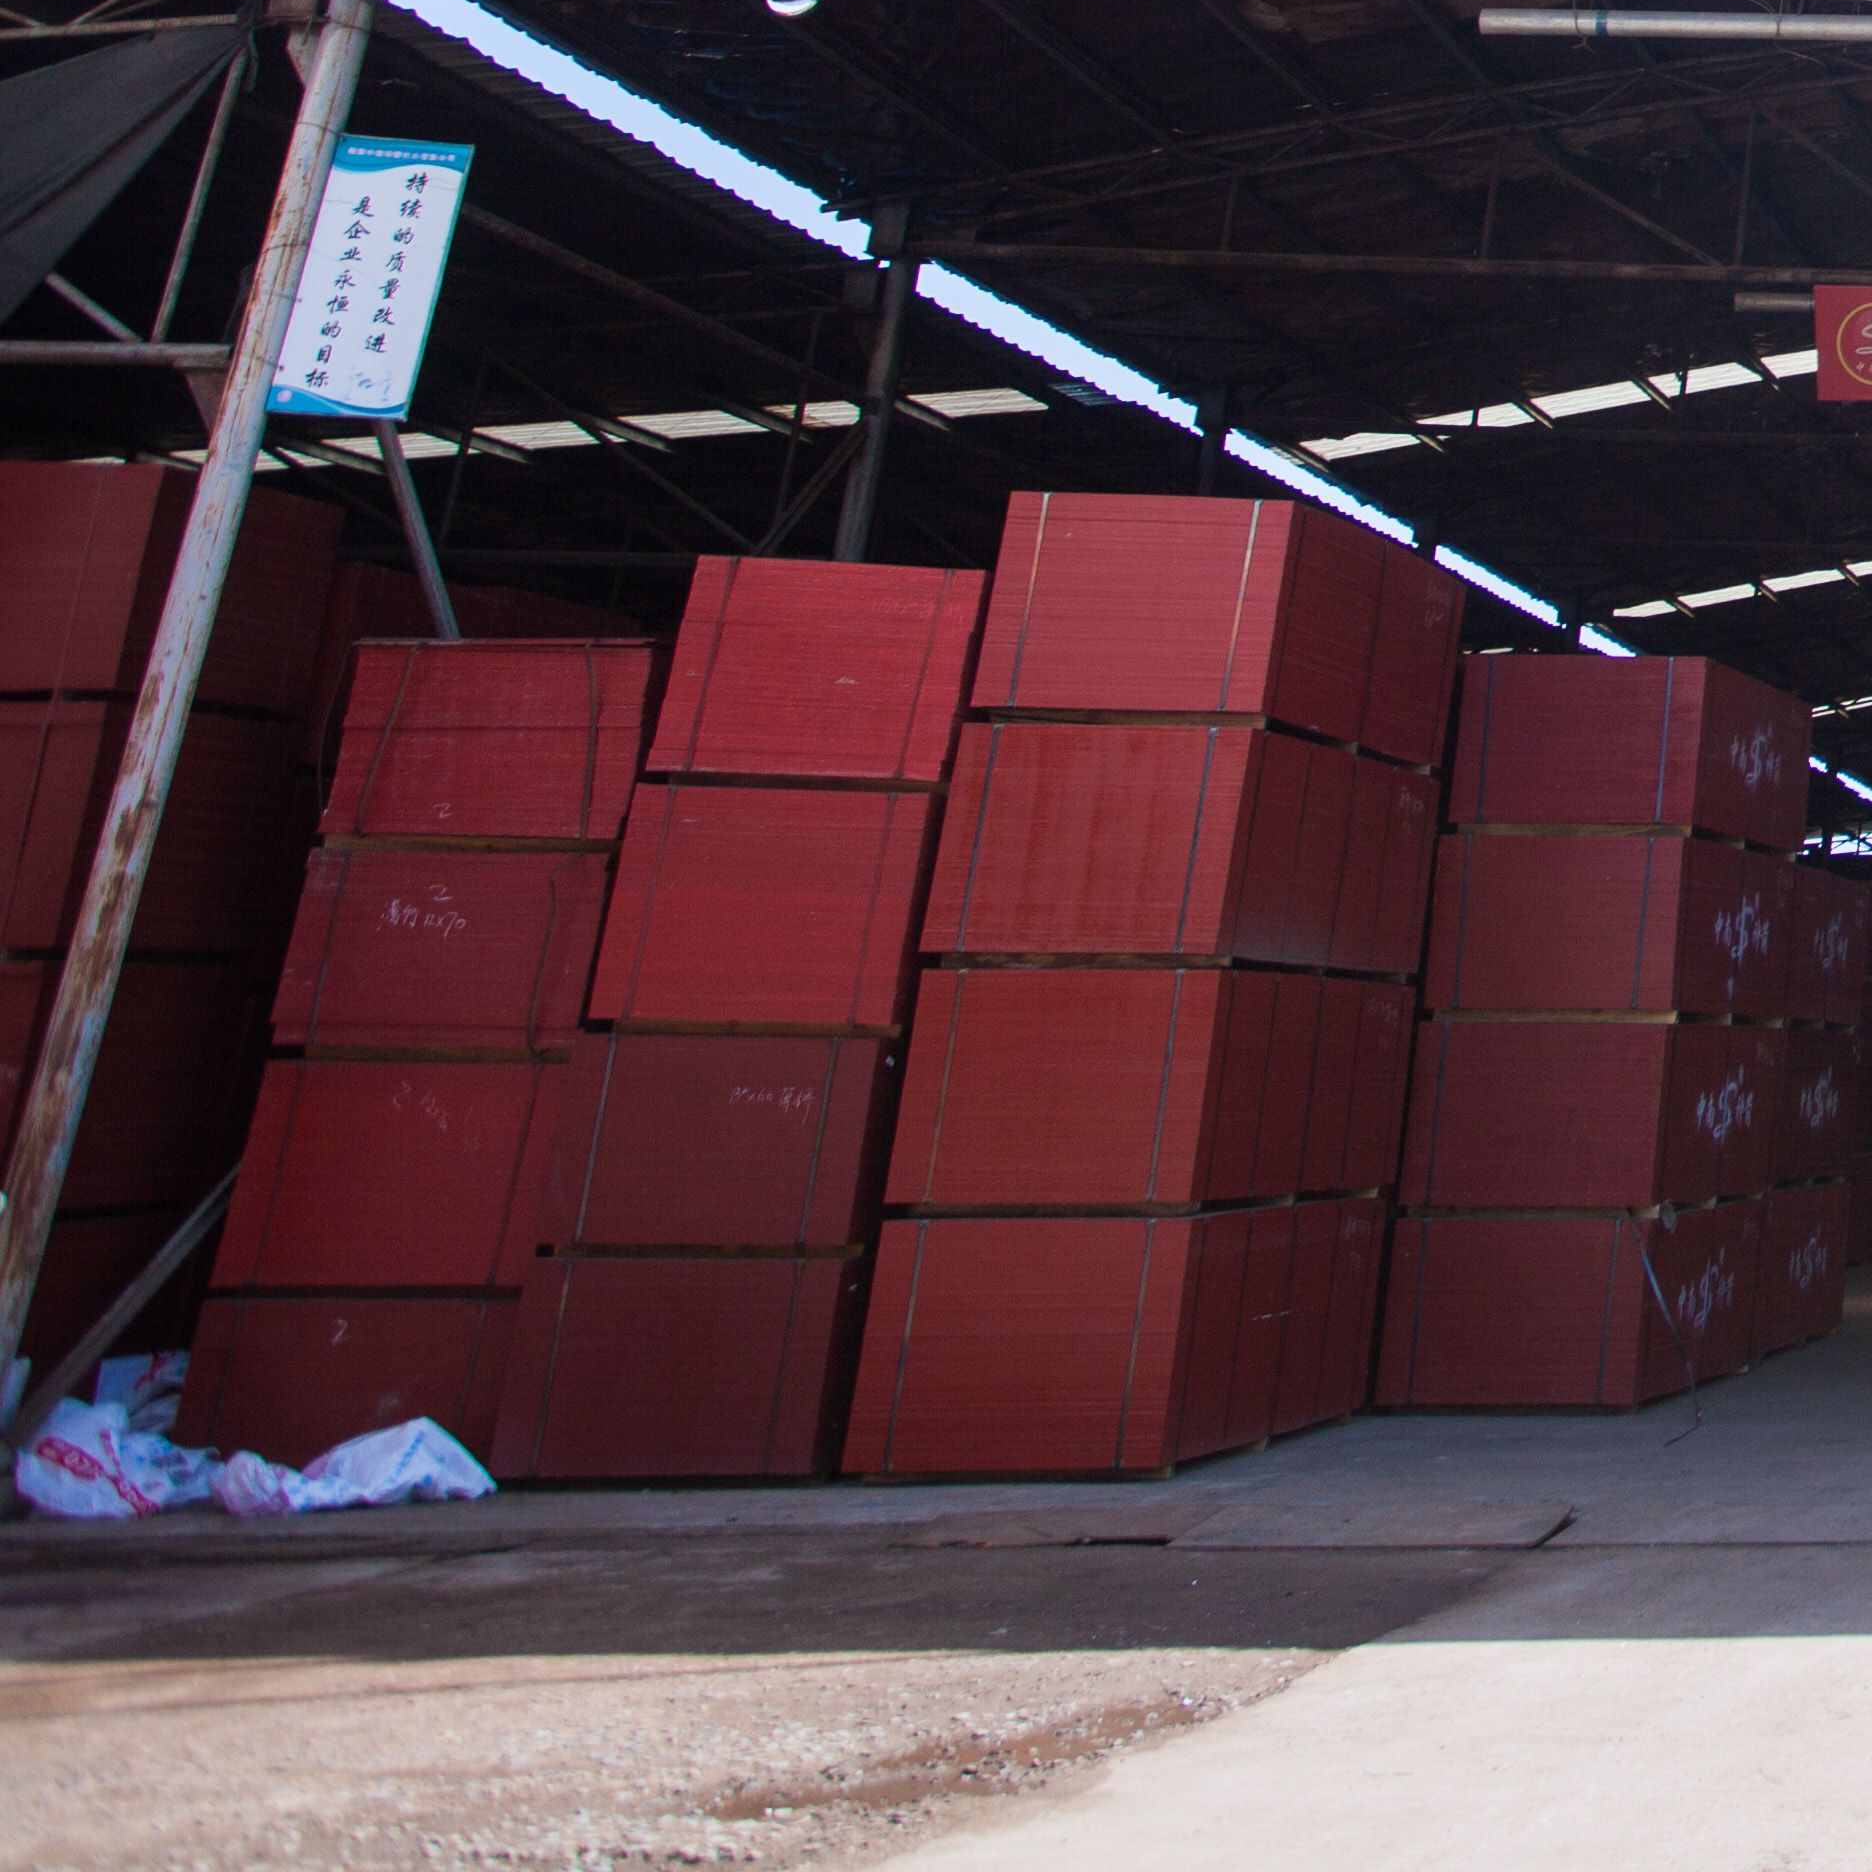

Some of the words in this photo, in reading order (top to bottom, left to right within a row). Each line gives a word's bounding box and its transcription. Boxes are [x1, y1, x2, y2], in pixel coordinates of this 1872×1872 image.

[305, 195, 375, 388] 是企业永恒的目标
[364, 172, 429, 354] 持续的质量改进
